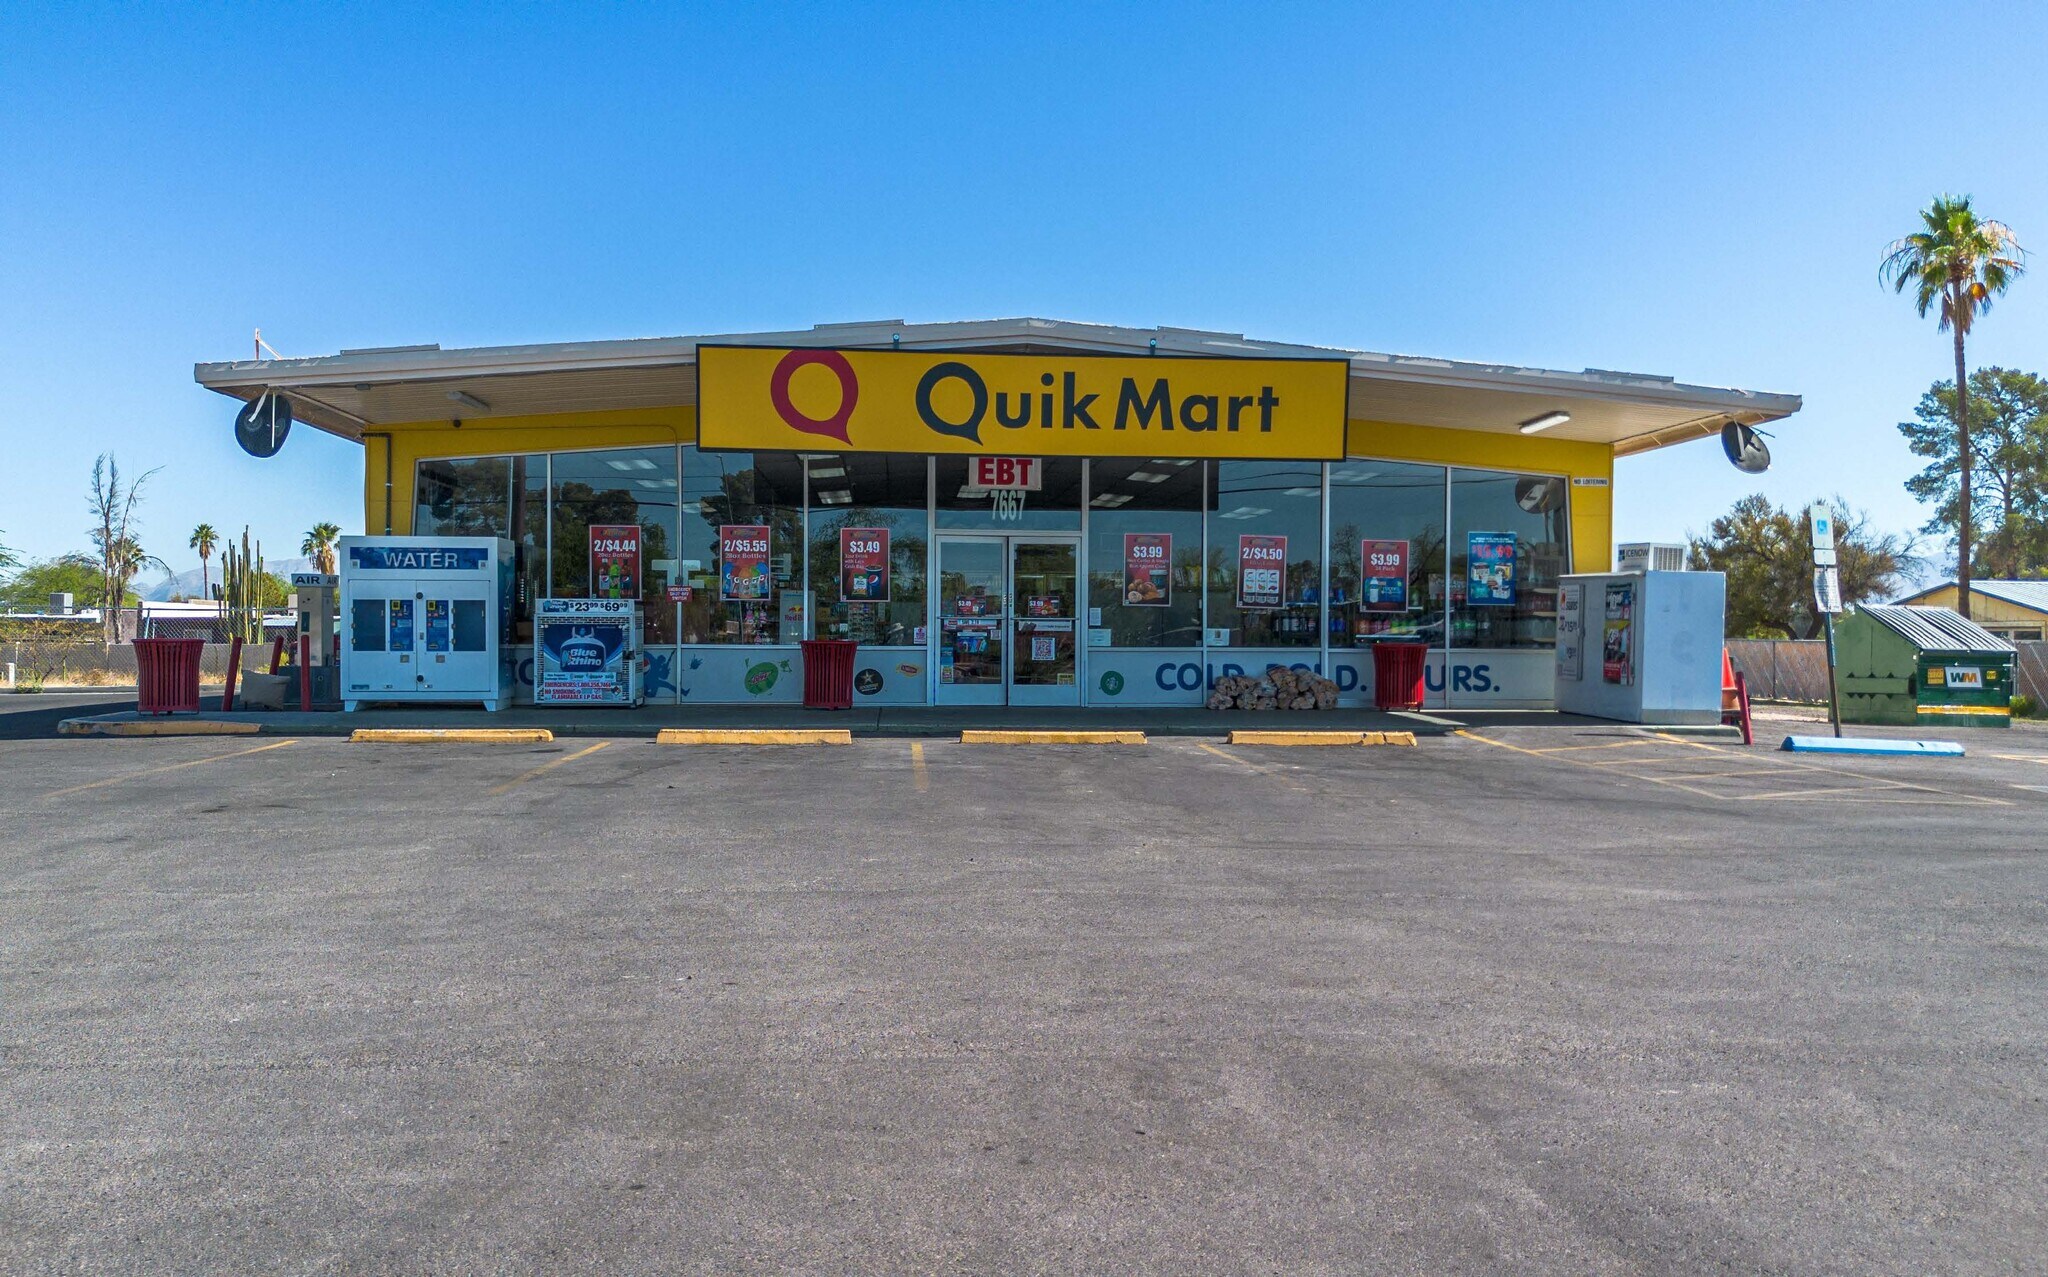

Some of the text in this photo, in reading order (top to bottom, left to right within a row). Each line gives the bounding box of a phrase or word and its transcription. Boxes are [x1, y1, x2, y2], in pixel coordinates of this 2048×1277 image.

[916, 362, 1279, 446] Quik Mart
[978, 457, 1033, 486] EBT
[1574, 478, 1582, 486] NO
[990, 490, 1026, 520] 7667
[594, 539, 636, 552] 2/$4.44
[724, 539, 767, 552] 2/$5.55
[849, 540, 880, 553] $3.49
[1133, 545, 1163, 558] $3.99
[383, 552, 458, 568] WATER
[1243, 547, 1283, 560] 2/$4.50
[1370, 553, 1400, 566] $3.99
[295, 576, 320, 584] AIR
[1950, 672, 1978, 683] WM
